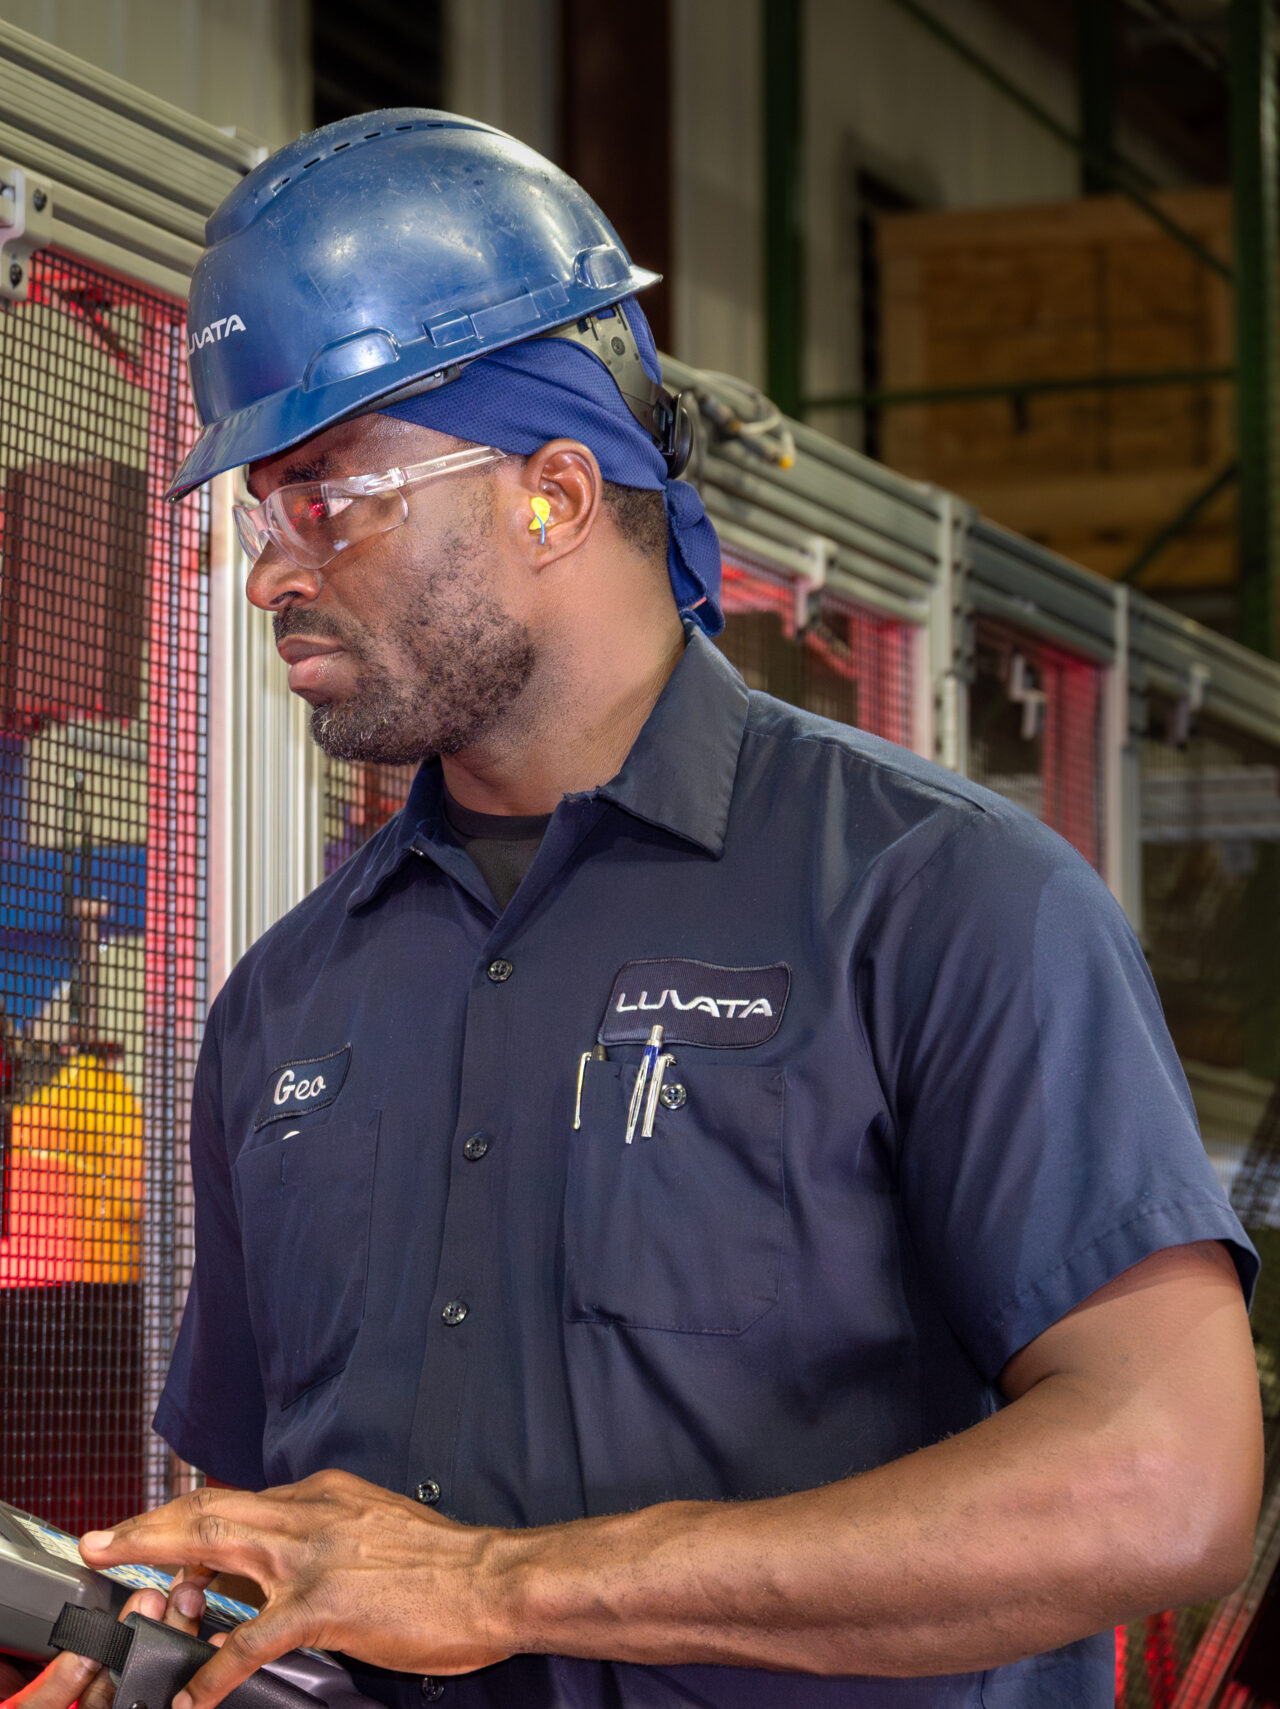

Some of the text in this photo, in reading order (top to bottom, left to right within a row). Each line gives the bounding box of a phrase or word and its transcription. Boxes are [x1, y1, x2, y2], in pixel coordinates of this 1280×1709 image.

[187, 314, 246, 355] UVATA
[616, 989, 773, 1018] LUVATA
[273, 1069, 326, 1105] Geo
